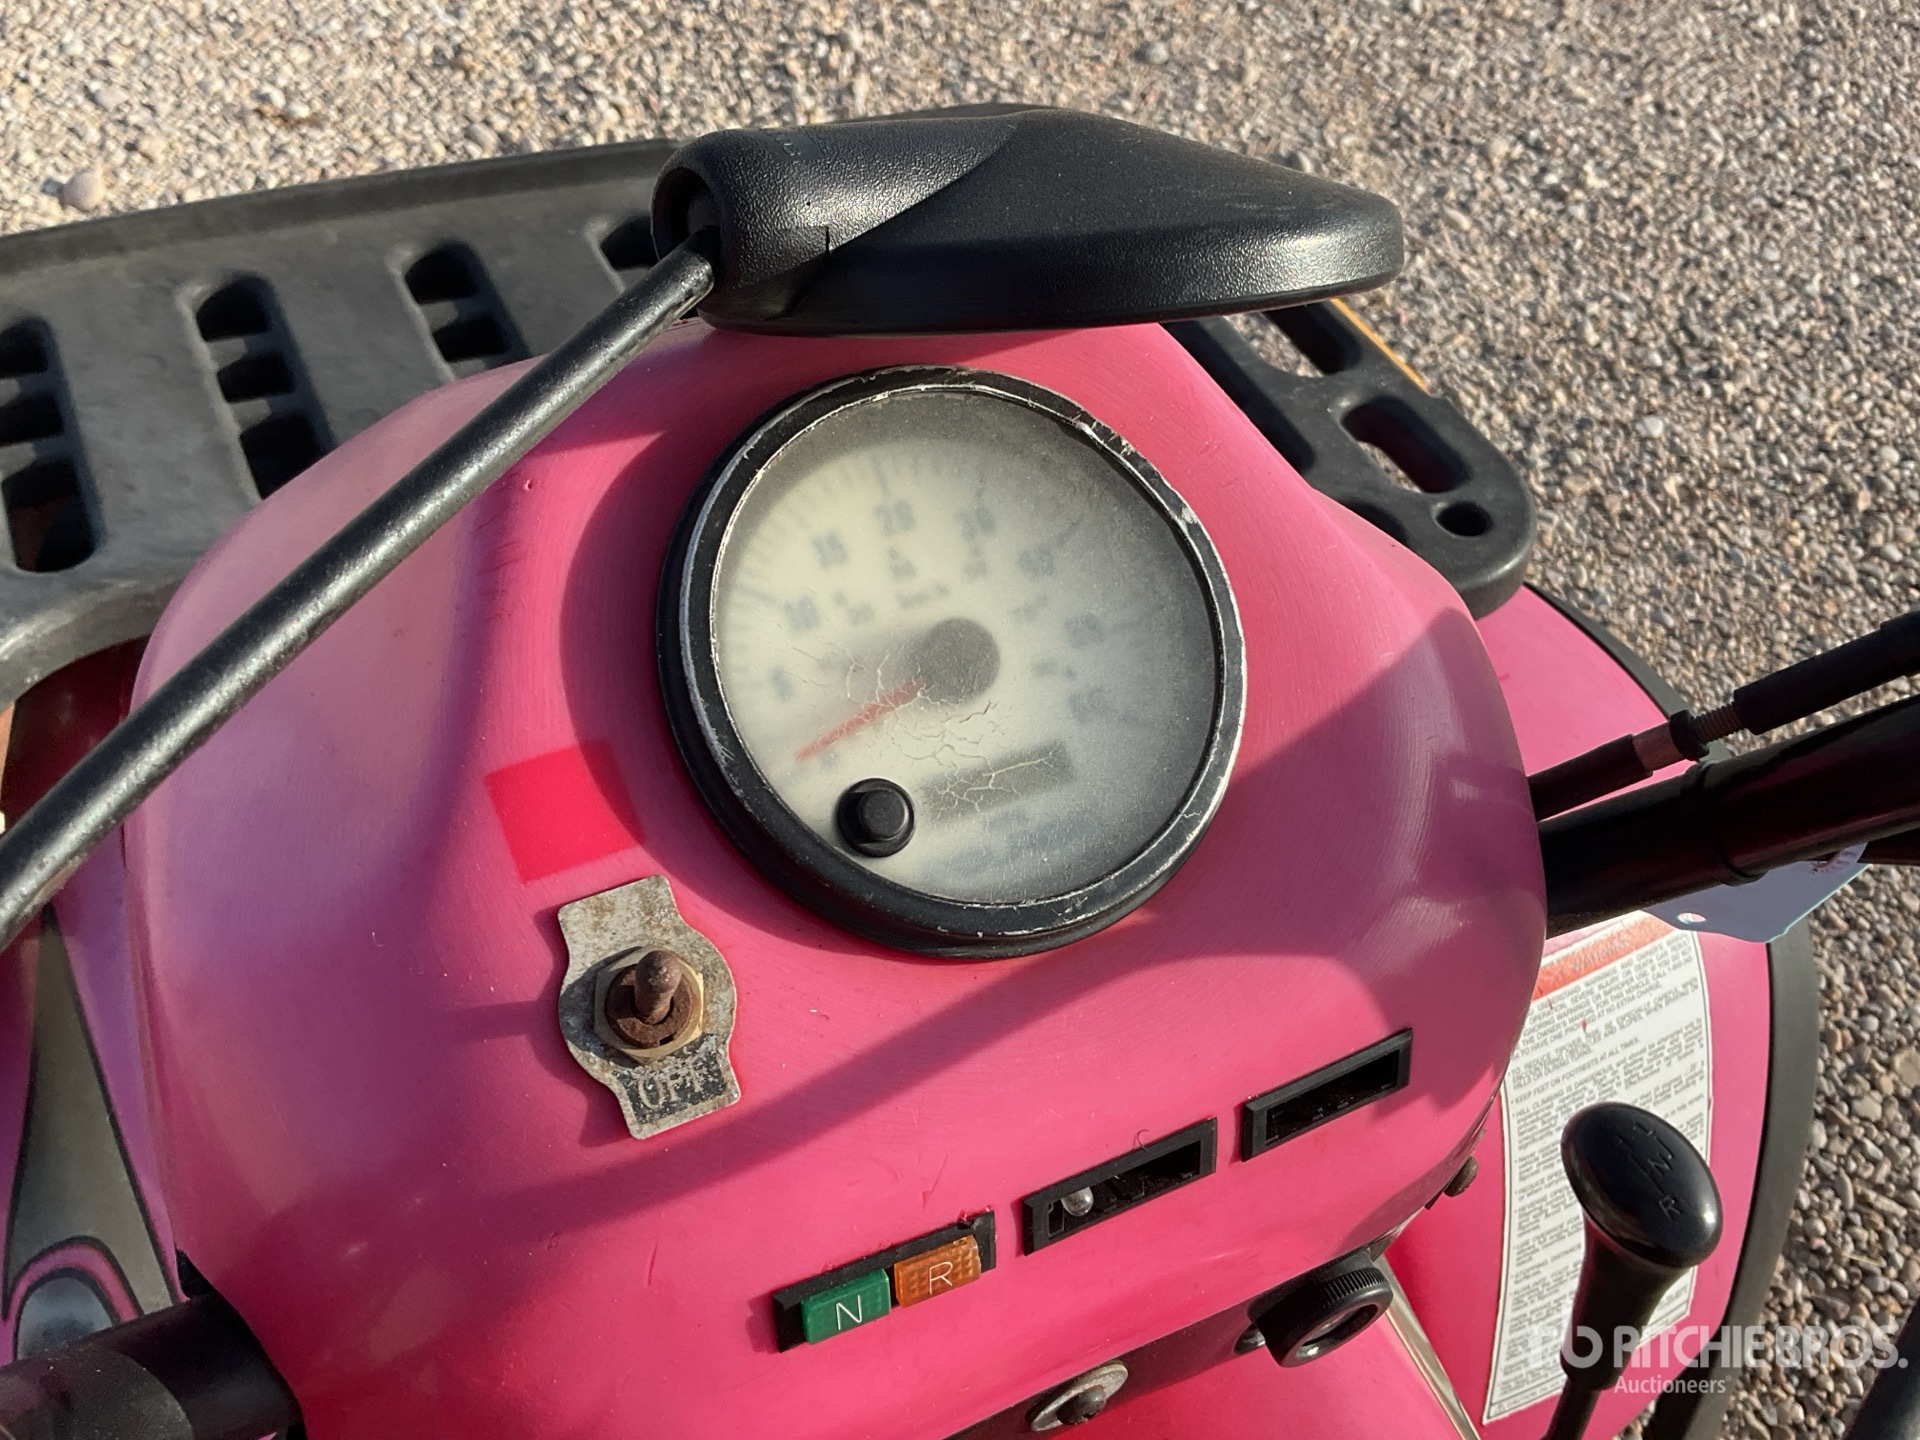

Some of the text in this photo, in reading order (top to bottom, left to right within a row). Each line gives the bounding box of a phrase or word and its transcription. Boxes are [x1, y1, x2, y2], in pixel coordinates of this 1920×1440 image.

[1634, 957, 1653, 971] DEATH
[1656, 950, 1668, 961] CAN
[1520, 1046, 1530, 1057] TO
[1531, 1037, 1549, 1052] HAVE
[1550, 1029, 1563, 1043] ONE
[1565, 1013, 1596, 1035] PROVED
[1606, 1003, 1615, 1014] NO
[1515, 1090, 1532, 1104] KEEP
[1533, 1082, 1549, 1096] FEET
[1550, 1077, 1560, 1087] ON
[1561, 1058, 1598, 1080] FOOTRESTS
[1608, 1046, 1619, 1057] ALL
[928, 1261, 953, 1295] R
[835, 1294, 862, 1331] N
